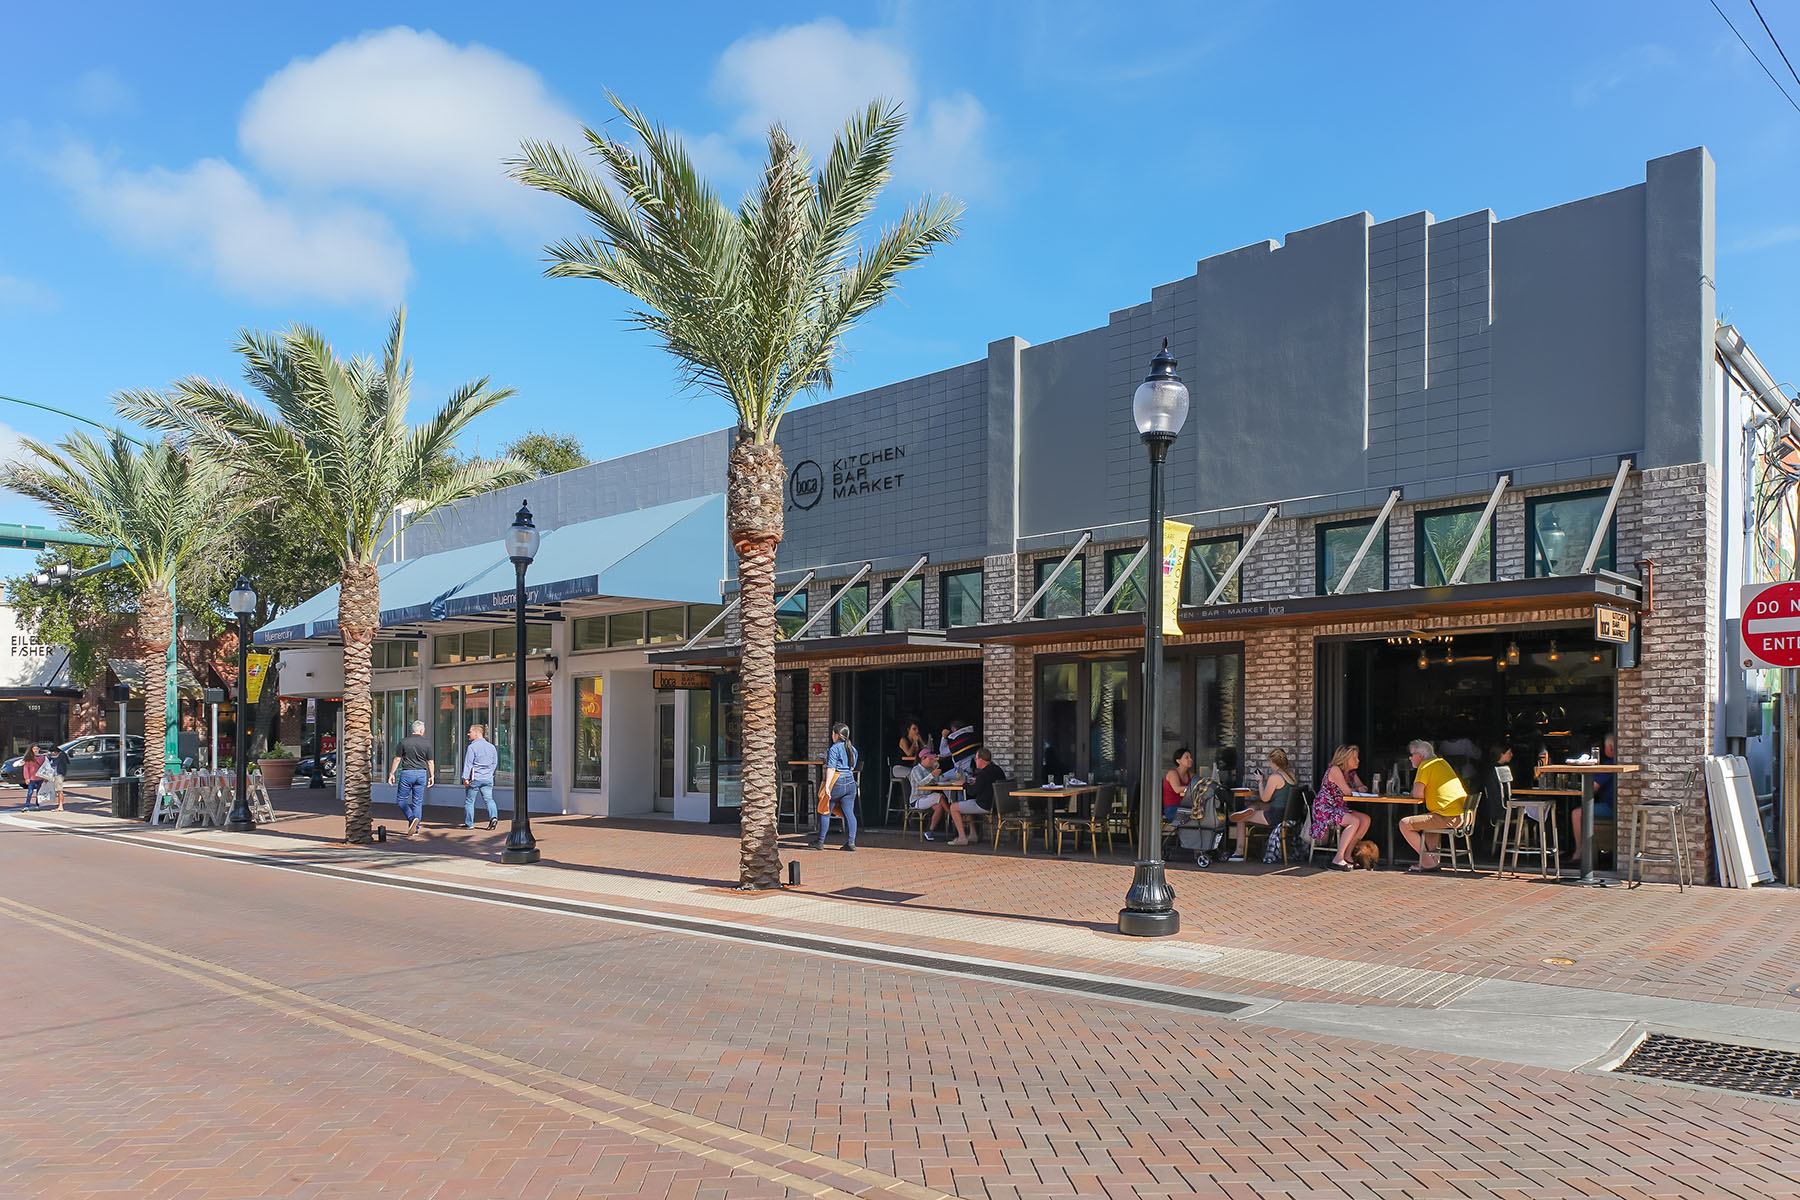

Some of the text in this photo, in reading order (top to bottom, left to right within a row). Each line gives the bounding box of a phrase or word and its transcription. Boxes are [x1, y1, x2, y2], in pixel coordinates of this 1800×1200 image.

[833, 446, 906, 472] KITCHEN
[796, 471, 818, 495] boca
[833, 467, 868, 486] BAR
[833, 473, 905, 500] MARKET
[492, 587, 539, 606] bluemury
[1228, 606, 1265, 615] MARKET
[1268, 602, 1285, 616] boca
[1757, 600, 1780, 615] DO
[11, 635, 50, 646] EILE
[264, 629, 294, 642] bluemercury
[11, 646, 54, 657] FISHER
[660, 671, 676, 687] boca
